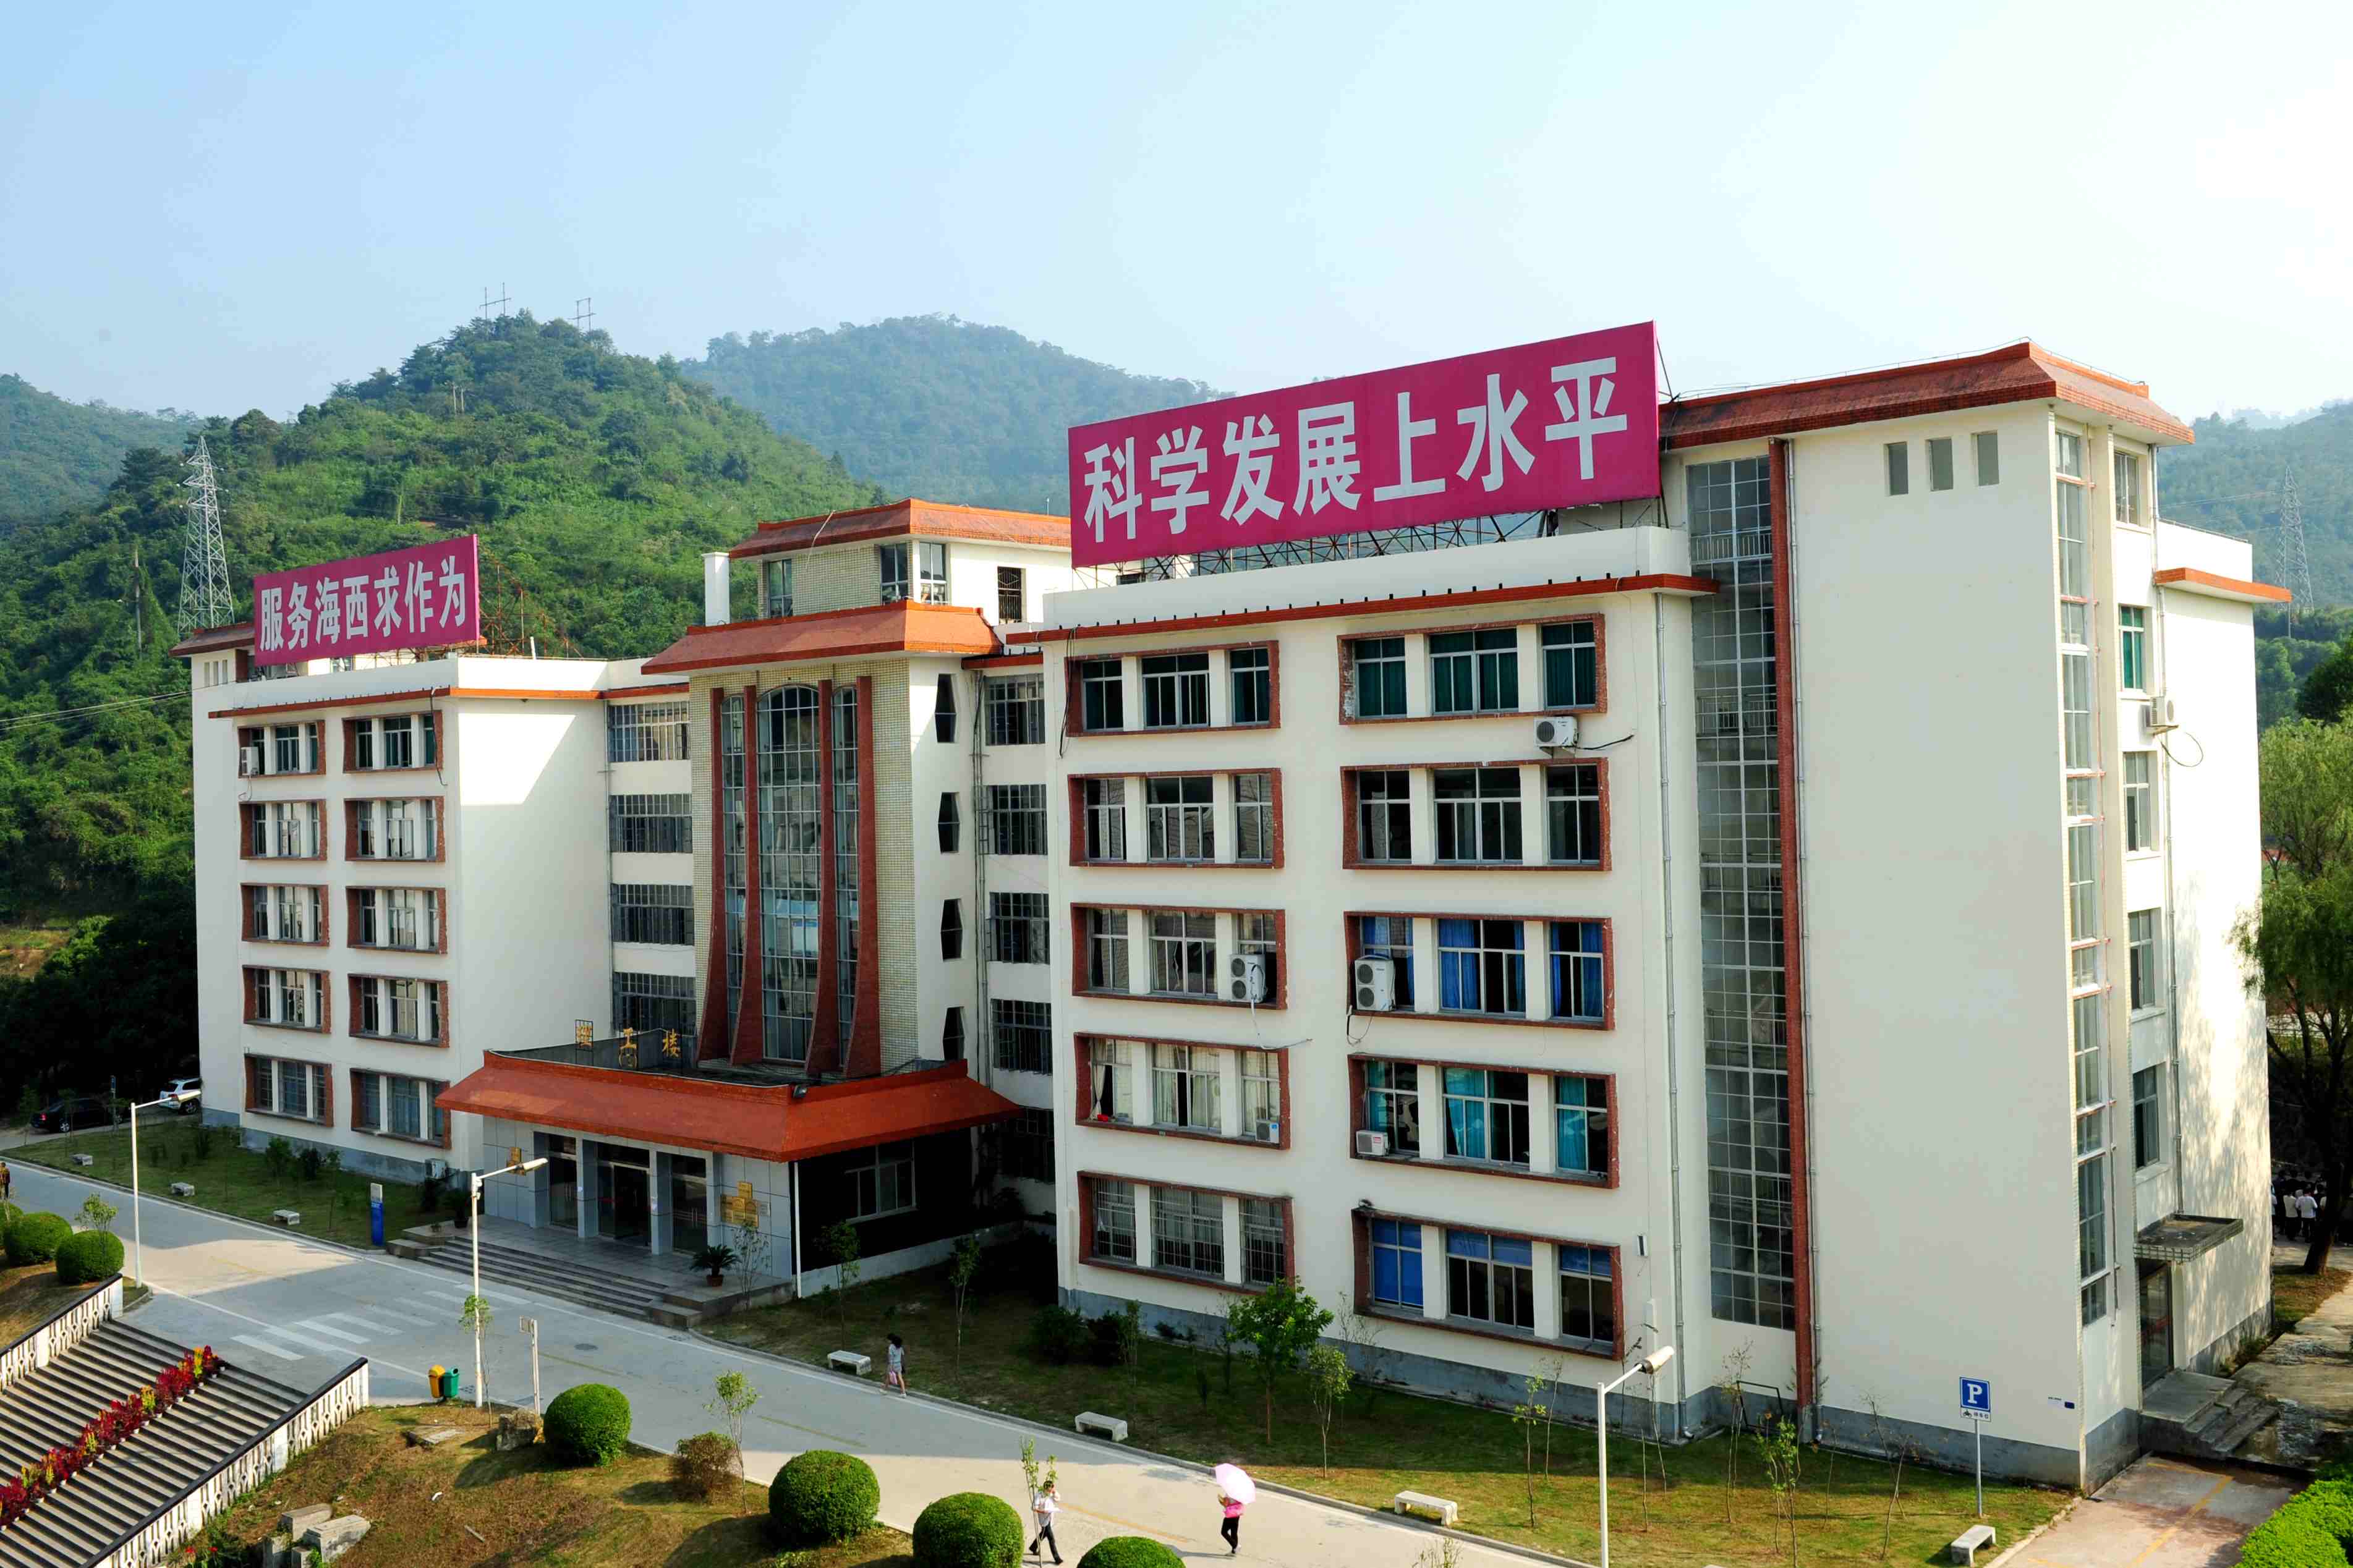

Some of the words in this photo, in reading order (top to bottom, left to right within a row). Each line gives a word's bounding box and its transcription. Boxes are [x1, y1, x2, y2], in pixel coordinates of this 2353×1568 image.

[1083, 355, 1628, 543] 科学发展上水平
[259, 555, 466, 652] 服务海西求作为
[1967, 1383, 1983, 1404] P
